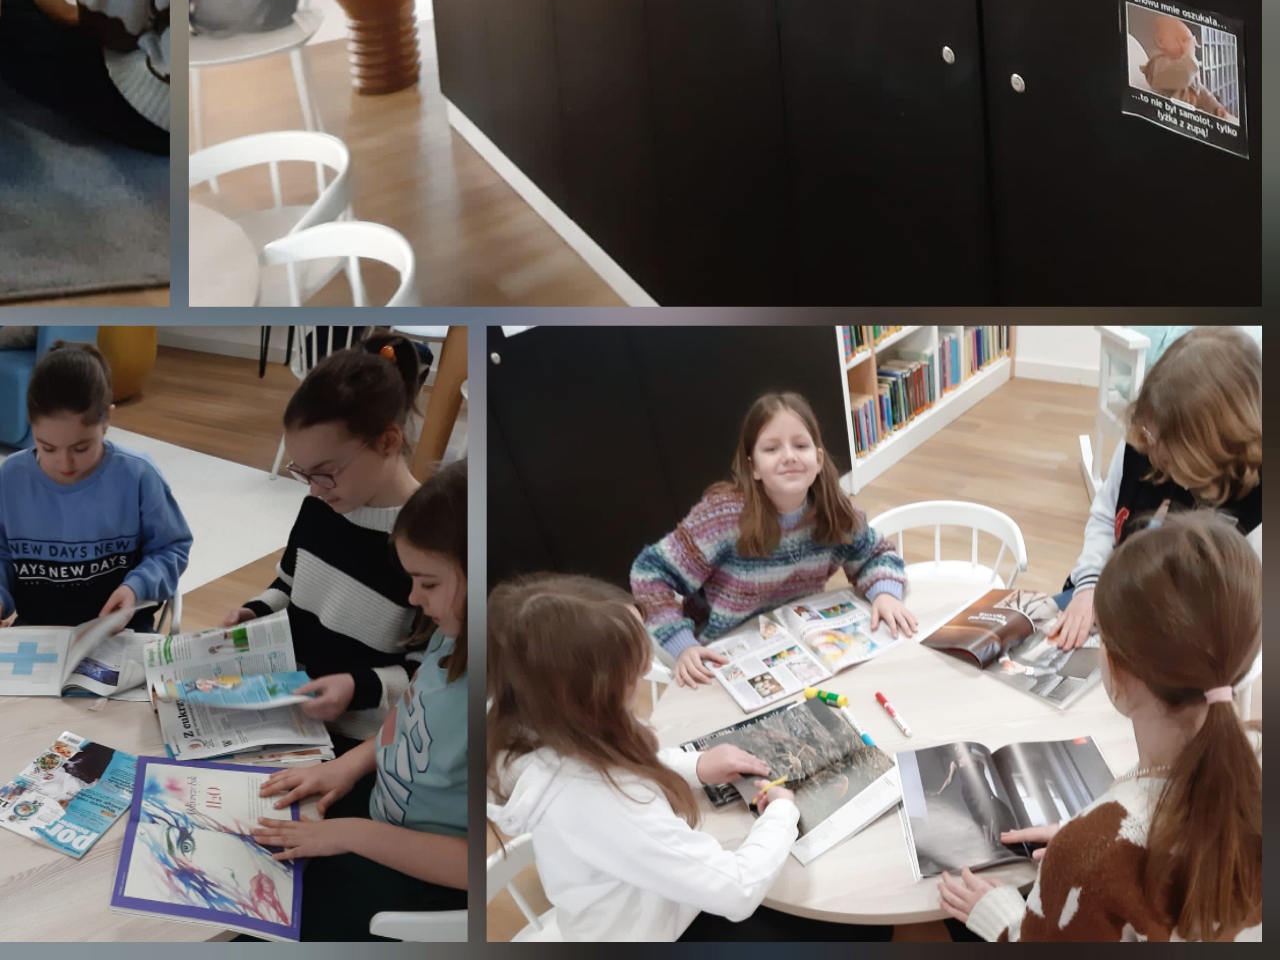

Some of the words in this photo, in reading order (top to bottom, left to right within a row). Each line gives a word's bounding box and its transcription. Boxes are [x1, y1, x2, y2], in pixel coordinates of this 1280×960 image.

[1160, 3, 1180, 16] mnie
[1150, 96, 1163, 109] nie
[1179, 108, 1214, 130] samolot,
[1216, 121, 1238, 137] tylko
[9, 543, 43, 556] NEW
[49, 545, 88, 558] DAYS
[94, 540, 131, 556] NEW
[49, 565, 85, 578] NEW
[90, 555, 127, 574] DAYS
